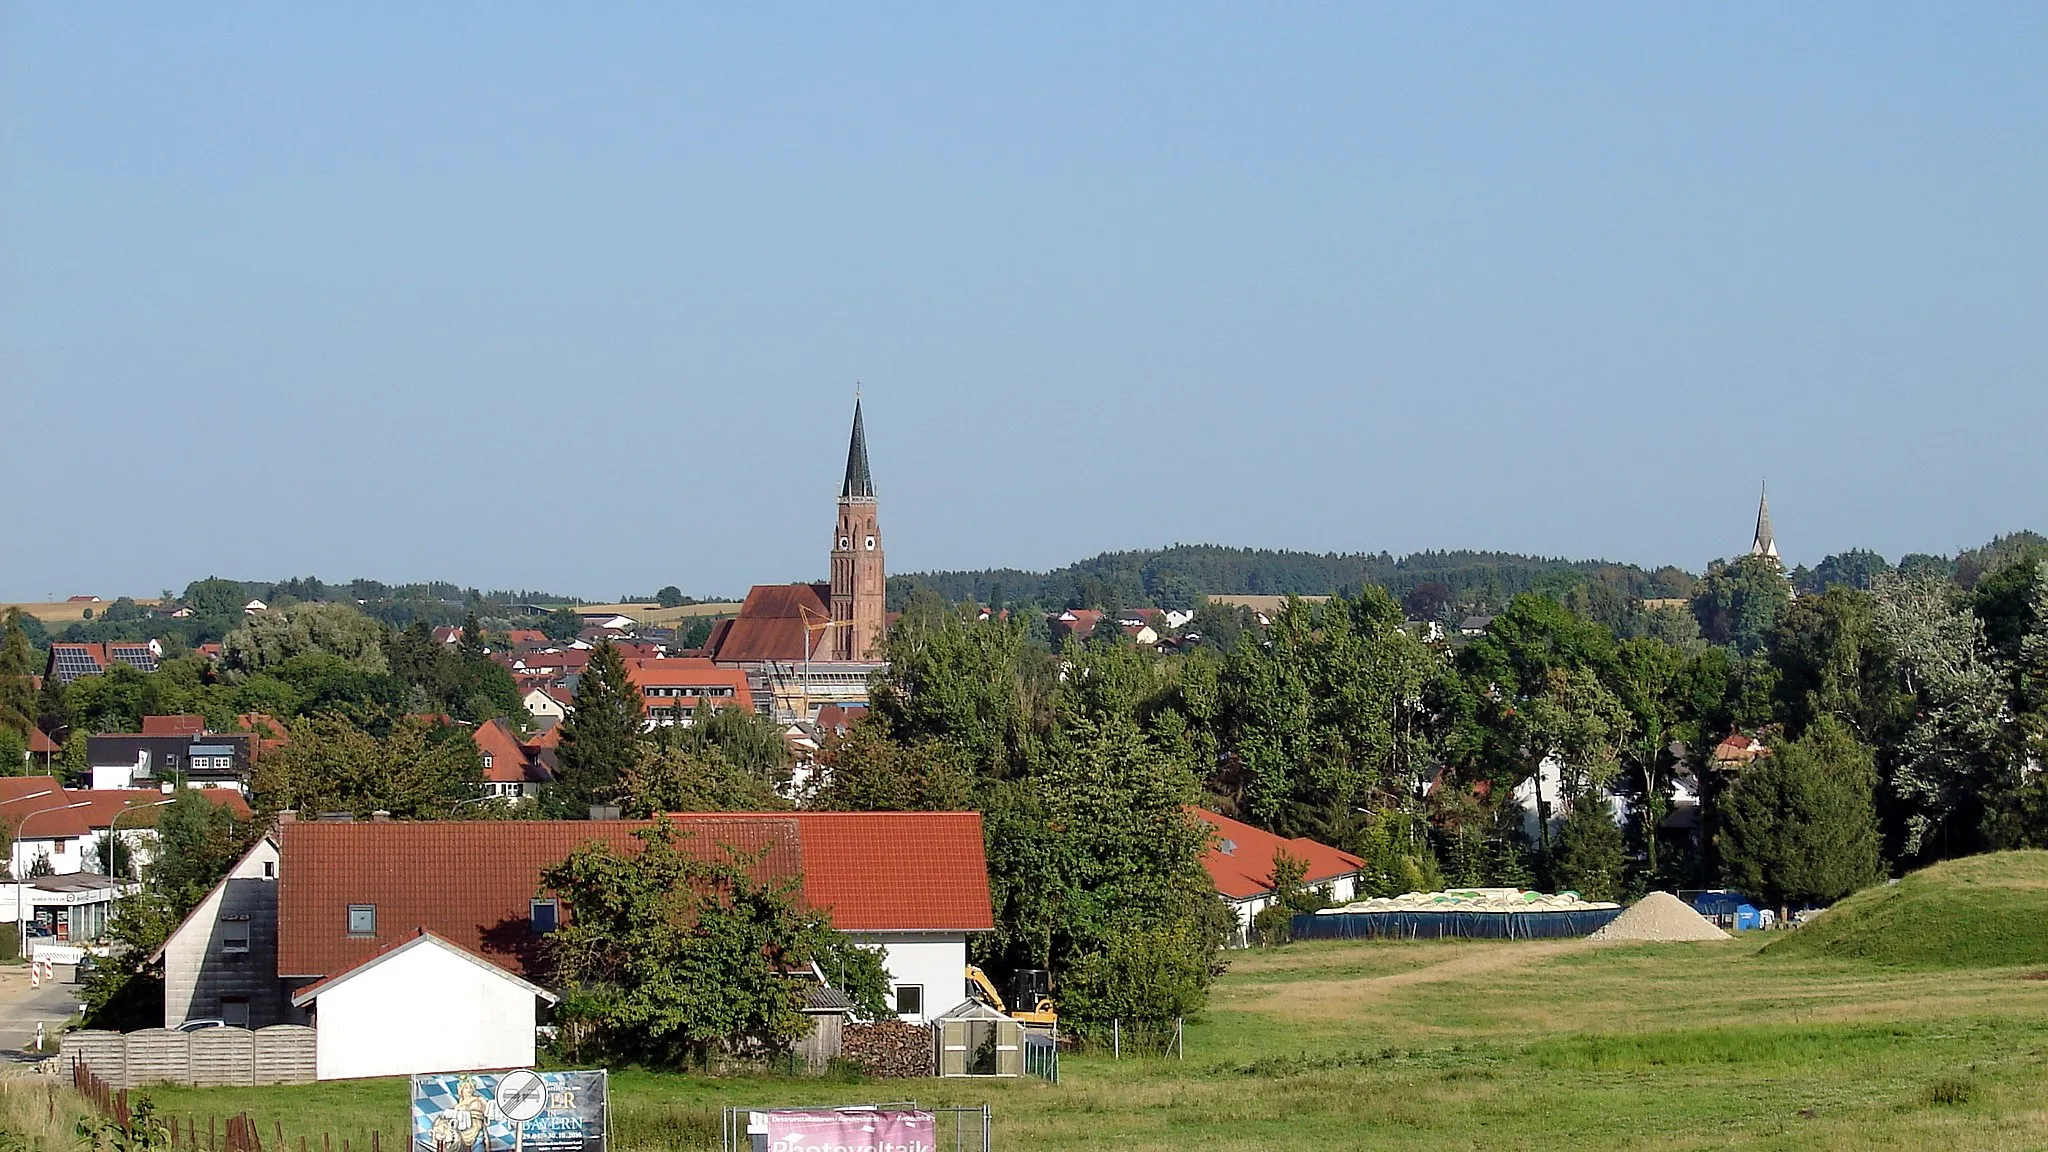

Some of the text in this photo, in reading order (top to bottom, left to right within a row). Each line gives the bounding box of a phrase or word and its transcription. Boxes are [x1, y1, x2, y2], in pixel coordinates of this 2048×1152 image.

[549, 1091, 577, 1110] ER
[547, 1109, 557, 1117] IN
[522, 1117, 583, 1131] BAYERN
